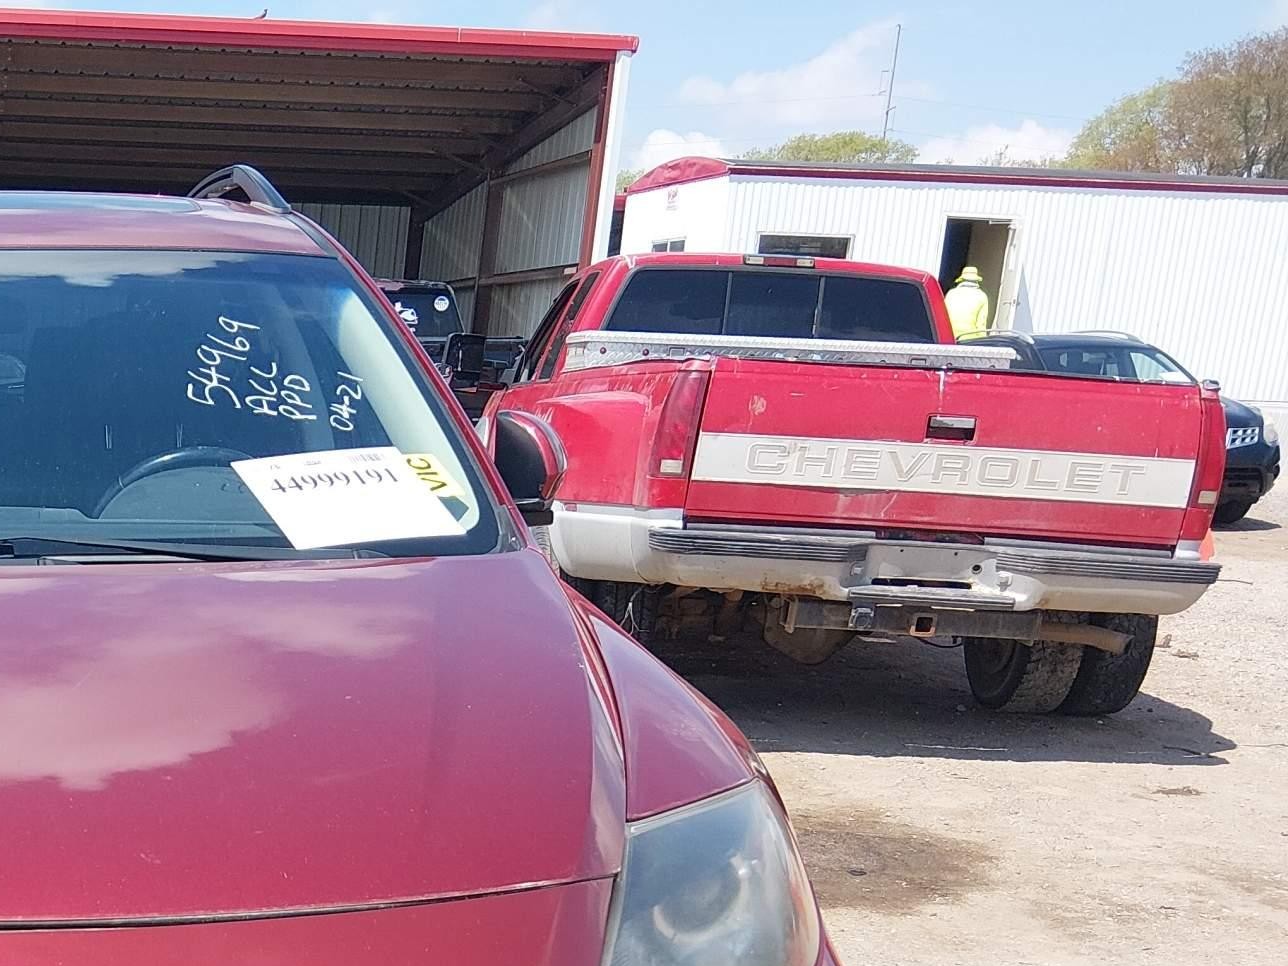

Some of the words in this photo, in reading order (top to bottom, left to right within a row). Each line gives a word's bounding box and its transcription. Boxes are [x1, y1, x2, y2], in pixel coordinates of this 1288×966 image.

[186, 316, 261, 409] 54969
[271, 467, 398, 493] 44999191
[745, 441, 1147, 496] CHEVROLET
